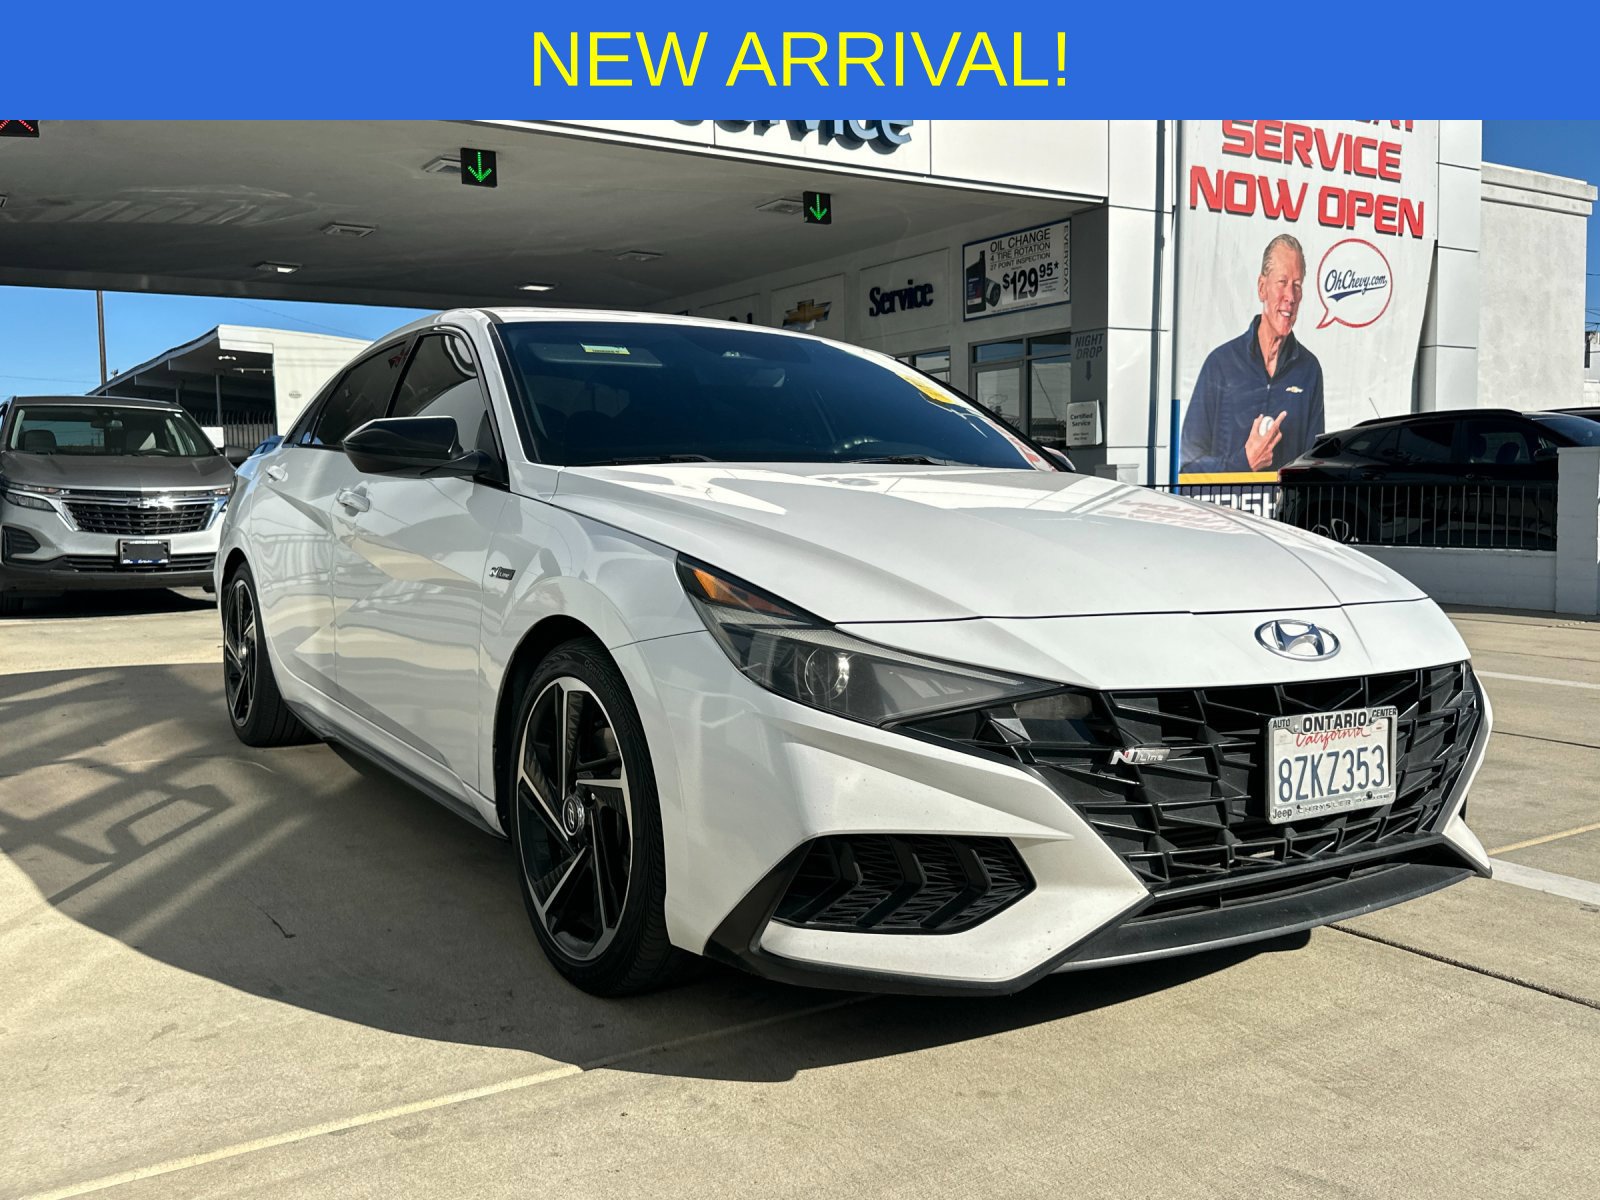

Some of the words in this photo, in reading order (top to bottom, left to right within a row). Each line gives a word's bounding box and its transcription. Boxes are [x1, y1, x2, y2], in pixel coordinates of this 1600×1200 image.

[1222, 119, 1402, 183] SERVICE
[1190, 165, 1309, 222] NOW
[1318, 185, 1424, 239] OPEN
[990, 239, 1005, 253] OIL
[1008, 228, 1051, 252] CHANGE
[997, 250, 1012, 261] TIRE
[1014, 241, 1051, 257] ROTATION
[998, 259, 1015, 269] POINT
[1016, 251, 1051, 266] INSPECTION
[1002, 266, 1039, 301] $129
[1324, 269, 1388, 296] OhChevy.com
[869, 279, 934, 317] Service
[1075, 333, 1104, 349] NIGHT
[1076, 346, 1103, 360] DROP
[1070, 412, 1093, 421] Certified
[1273, 718, 1291, 729] AUTO
[1302, 711, 1367, 733] ONTARIO
[1372, 707, 1397, 718] CENTER
[1278, 744, 1385, 802] 8ZKZ353
[1272, 808, 1293, 819] Jeep
